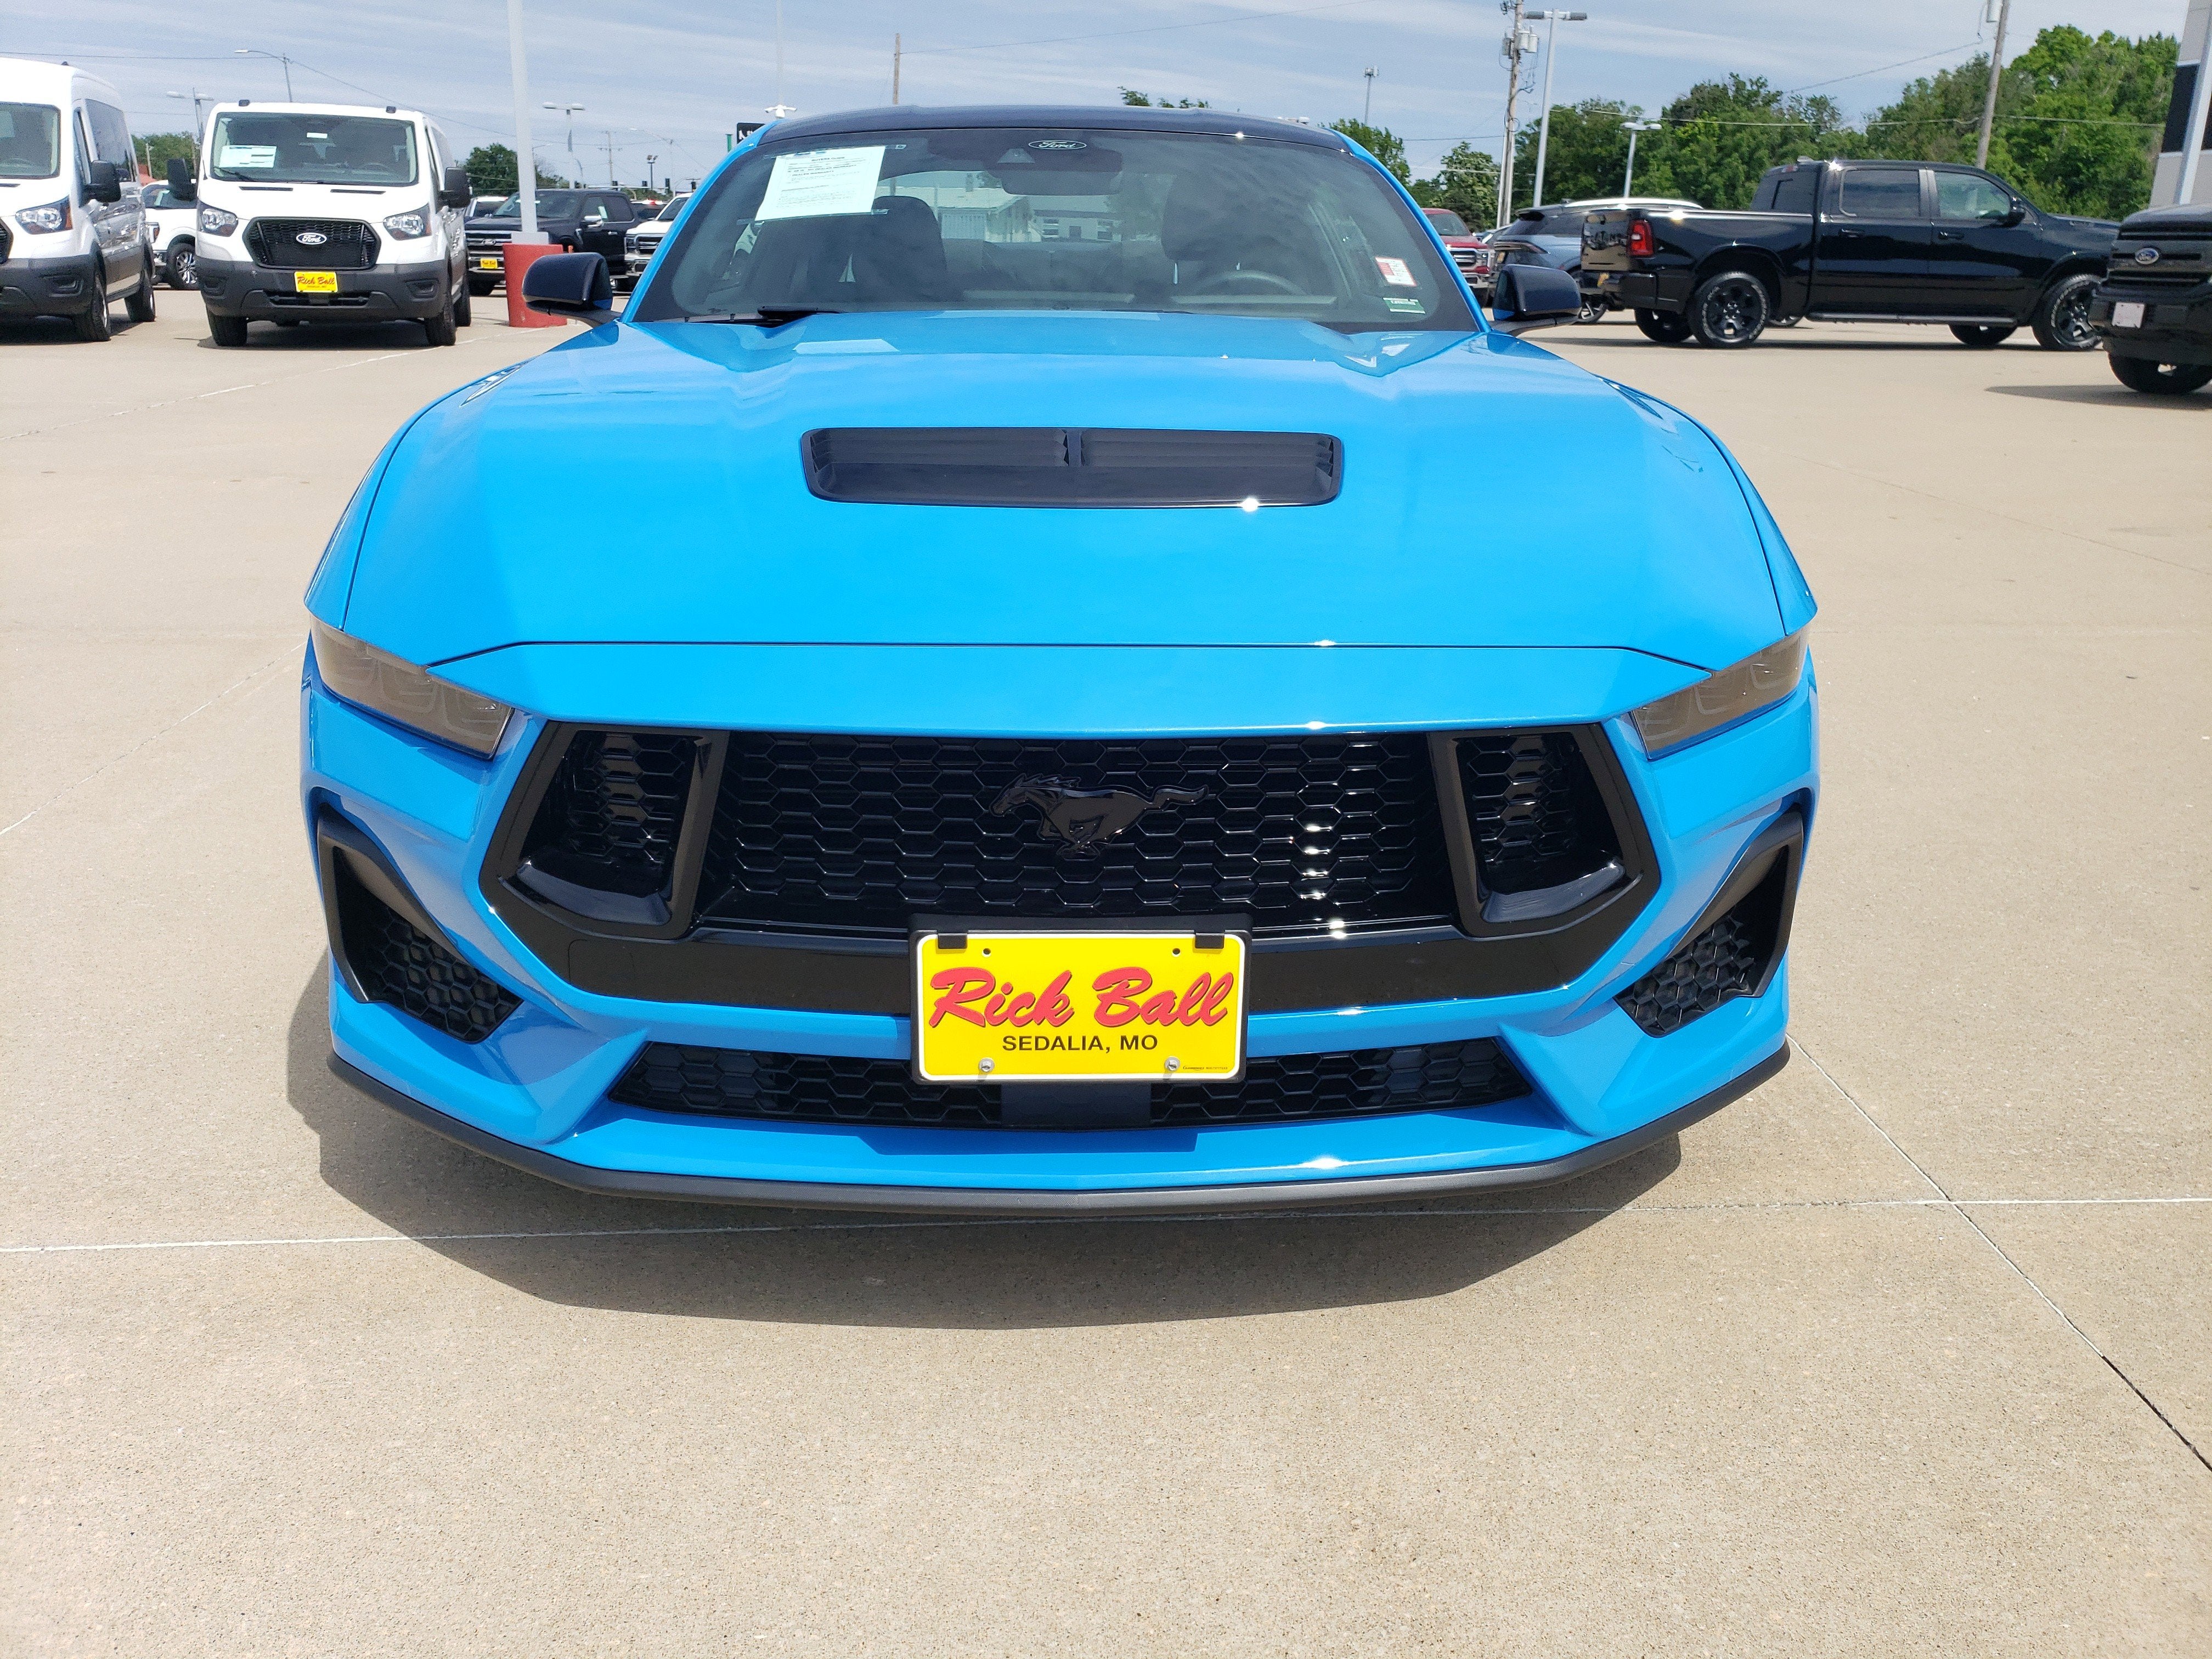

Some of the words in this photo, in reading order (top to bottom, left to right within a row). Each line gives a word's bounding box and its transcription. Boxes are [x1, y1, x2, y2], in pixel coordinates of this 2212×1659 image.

[318, 276, 335, 285] Ball
[929, 967, 1075, 1028] Rick
[1092, 967, 1234, 1028] Ball
[1002, 1035, 1110, 1053] SEDALIA,
[1120, 1035, 1158, 1050] MO
